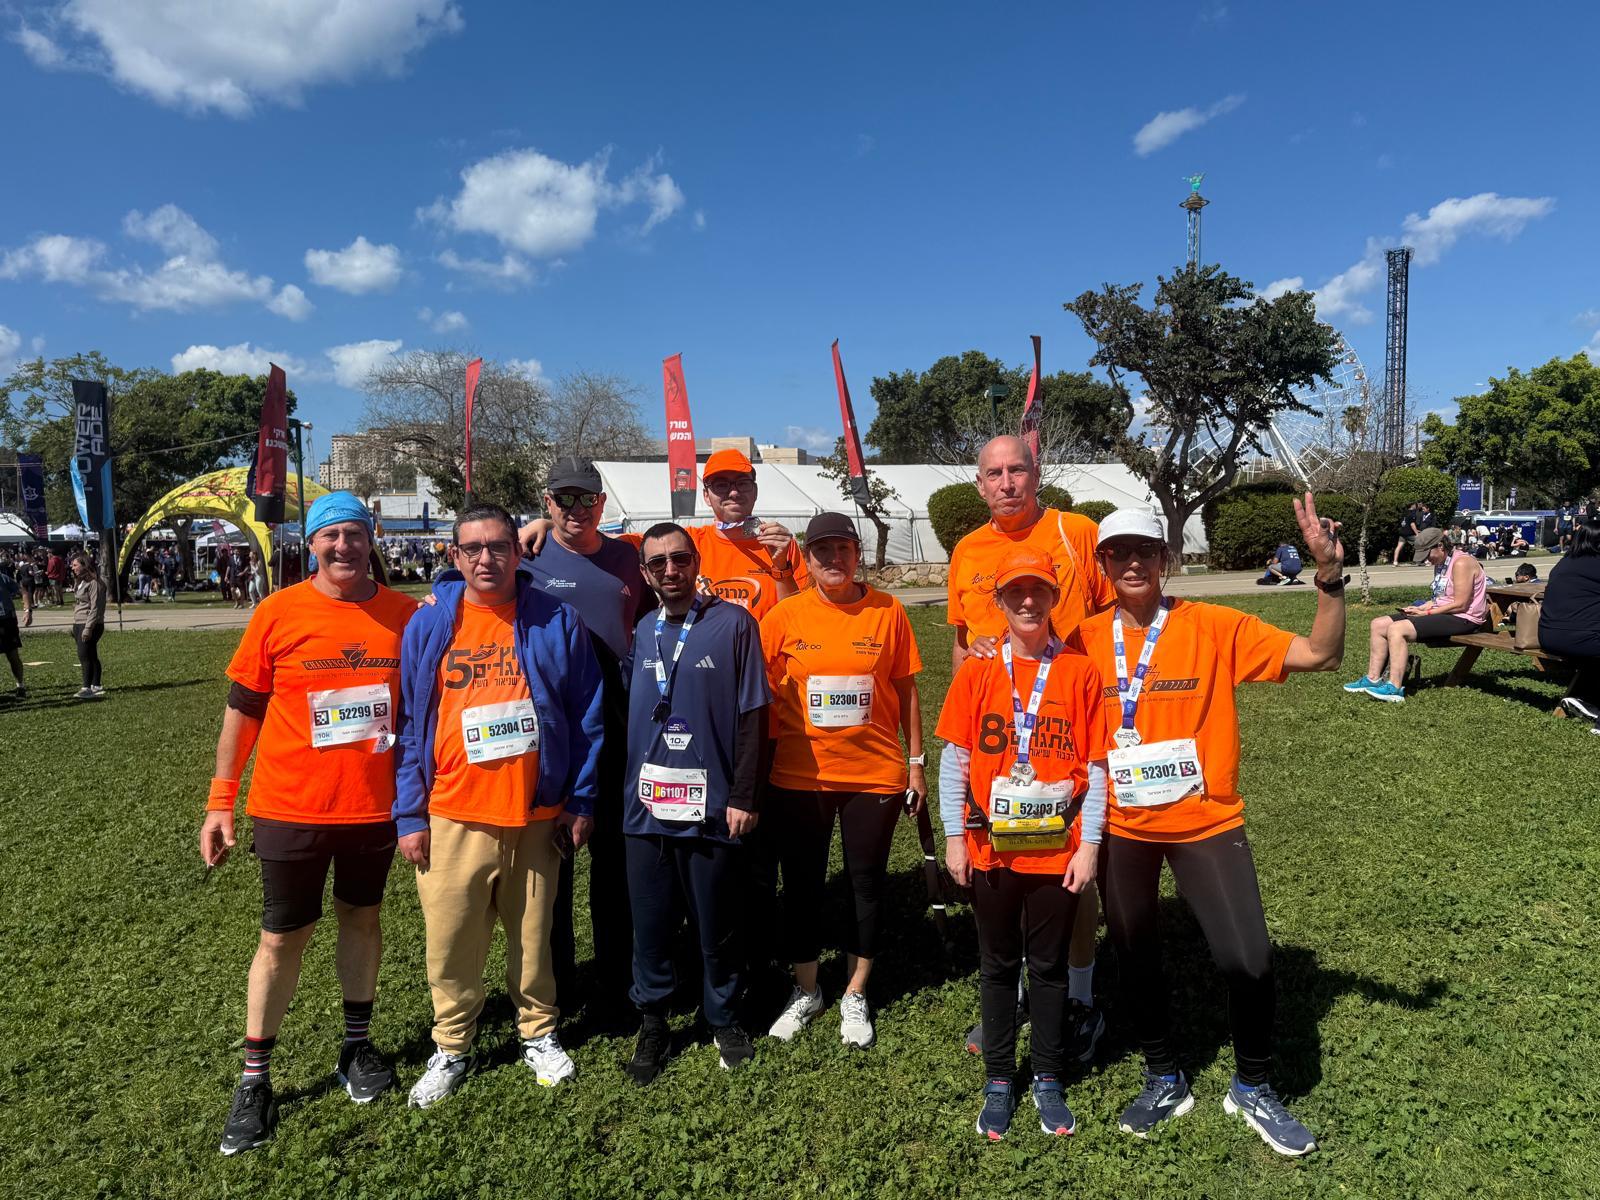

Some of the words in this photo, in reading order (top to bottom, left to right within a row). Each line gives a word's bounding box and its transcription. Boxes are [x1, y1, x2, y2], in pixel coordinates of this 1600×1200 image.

[444, 649, 473, 690] 5
[979, 712, 1009, 755] 8
[655, 785, 686, 799] D61107
